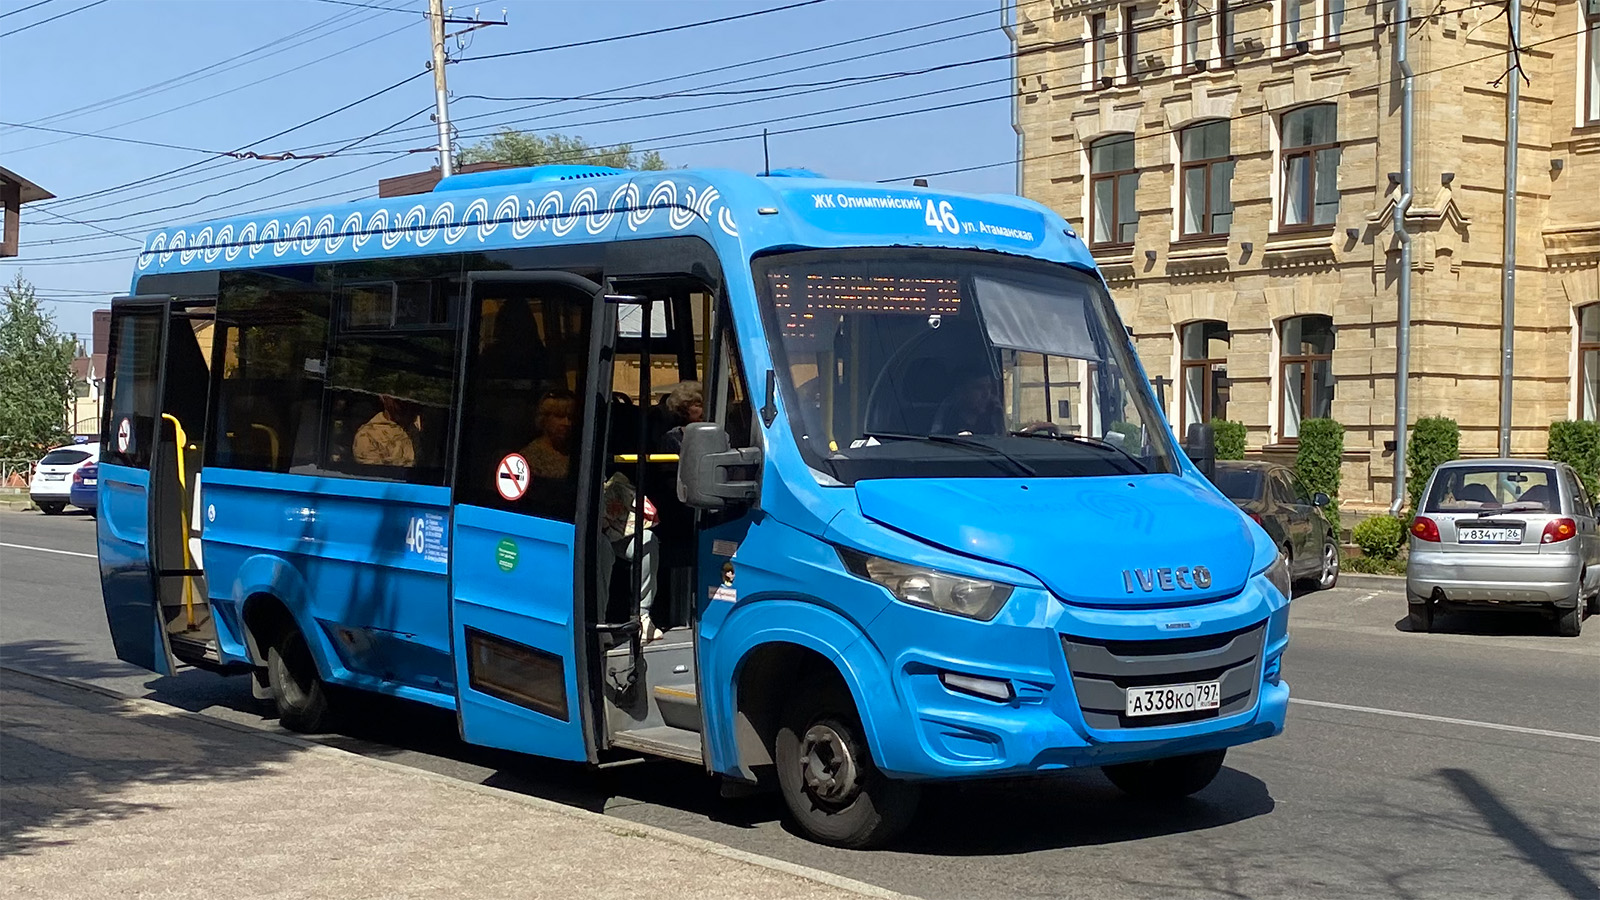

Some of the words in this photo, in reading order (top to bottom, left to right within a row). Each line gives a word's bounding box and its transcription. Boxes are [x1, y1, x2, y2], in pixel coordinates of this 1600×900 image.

[811, 194, 836, 208] ЖК
[837, 193, 922, 210] Олимпийский
[925, 199, 960, 235] 46
[961, 221, 979, 234] ул.
[979, 220, 1034, 241] Атаманская
[405, 517, 425, 554] 46
[1463, 529, 1504, 540] У834УТ
[1507, 529, 1518, 538] 26
[1122, 565, 1212, 593] IVECO
[1133, 689, 1194, 713] А338КО
[1196, 684, 1217, 702] 797
